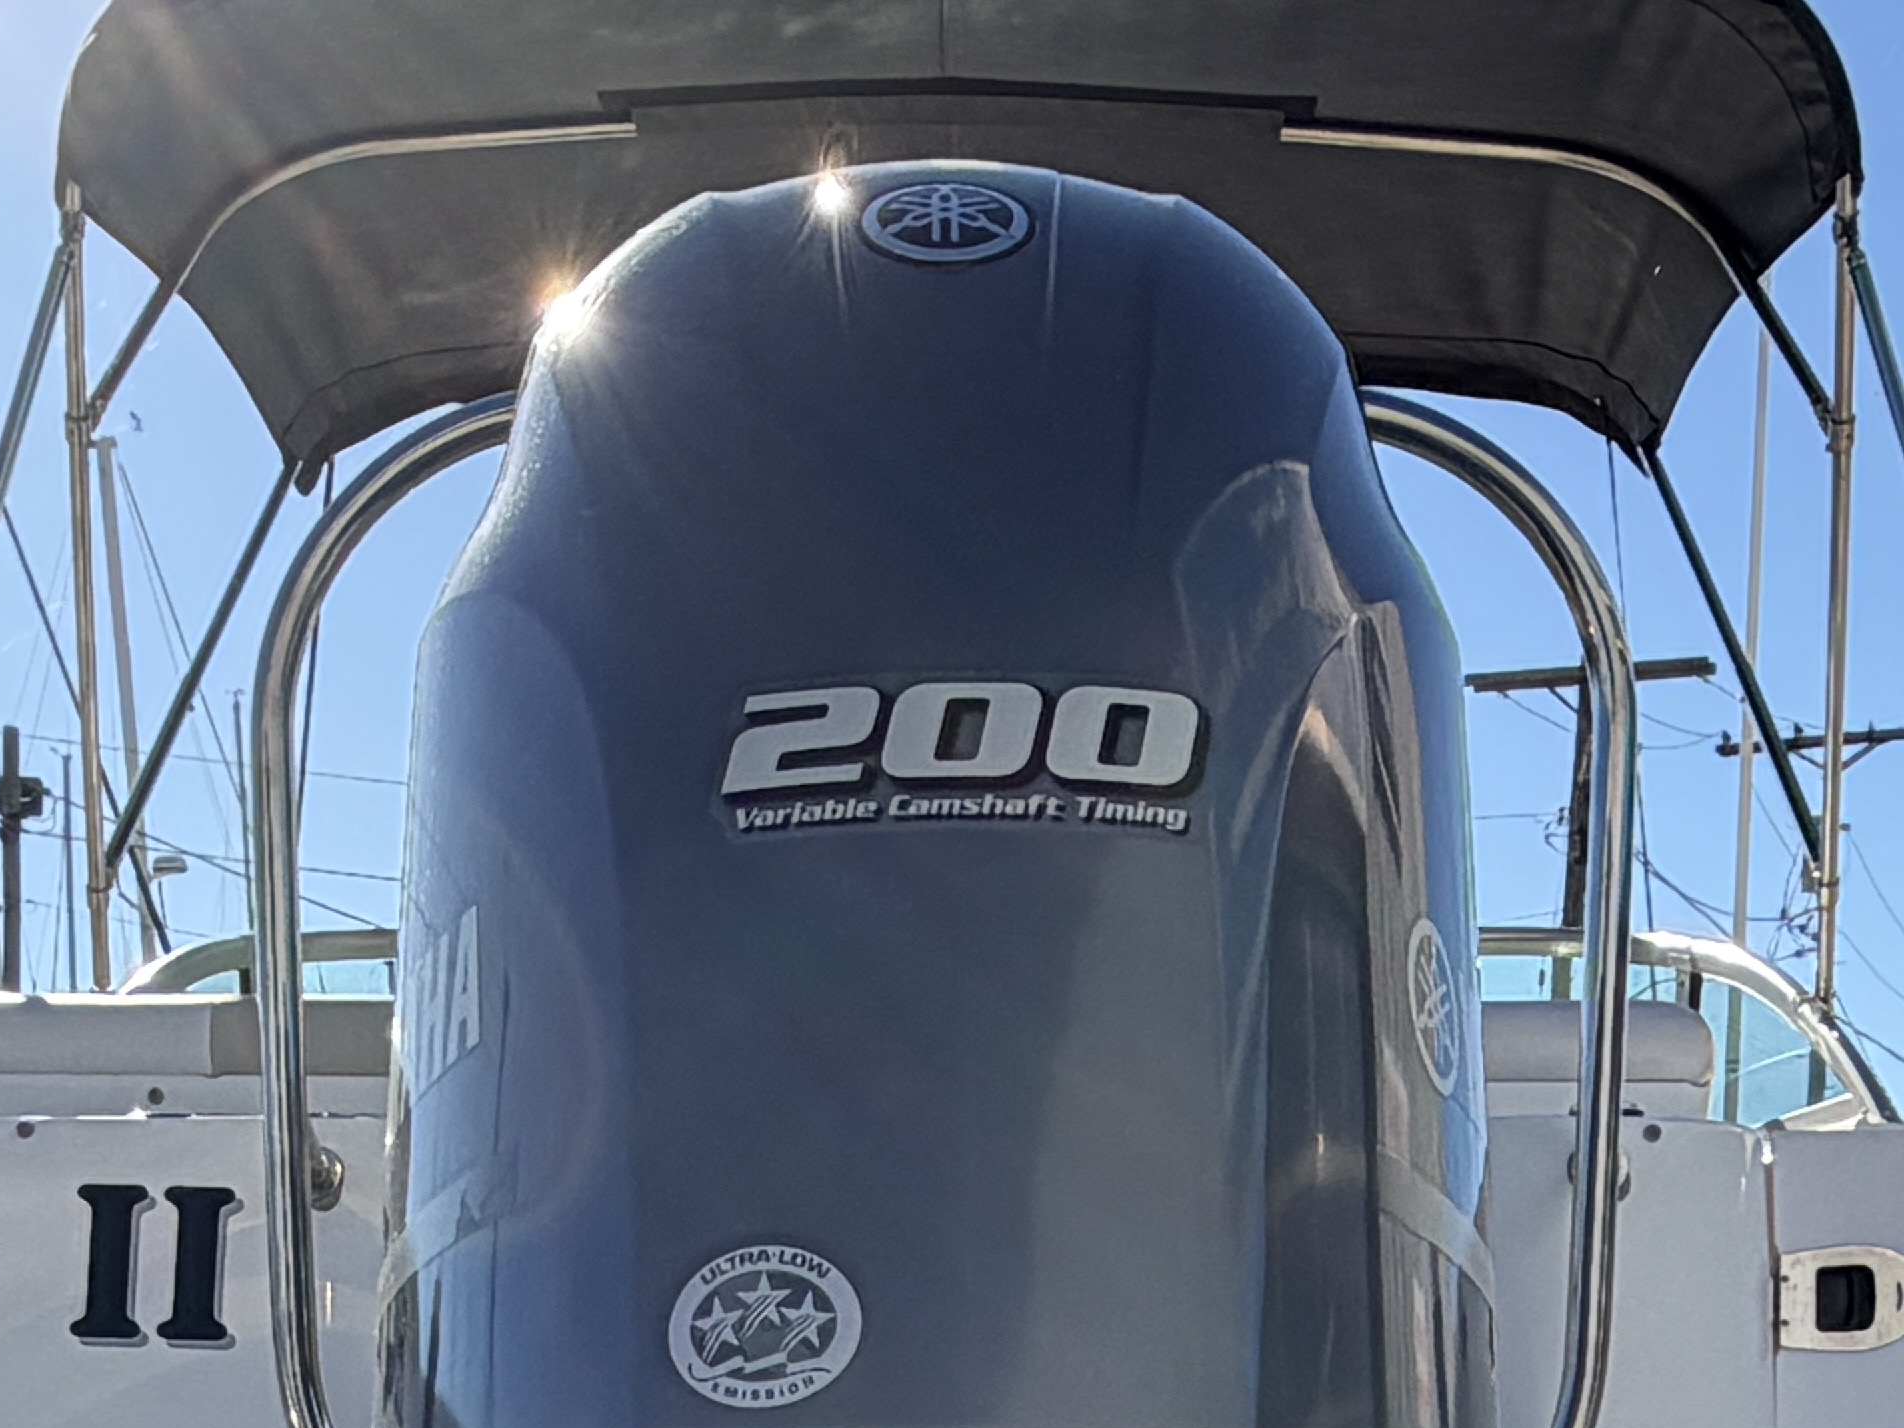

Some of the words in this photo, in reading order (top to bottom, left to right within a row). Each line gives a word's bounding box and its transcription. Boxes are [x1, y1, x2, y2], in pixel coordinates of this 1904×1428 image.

[721, 682, 1200, 796] 200
[736, 798, 878, 832] Variable
[889, 794, 1062, 819] Camshaft
[1076, 796, 1190, 831] Timing
[69, 1184, 243, 1349] II
[711, 1375, 815, 1401] EMISSION
